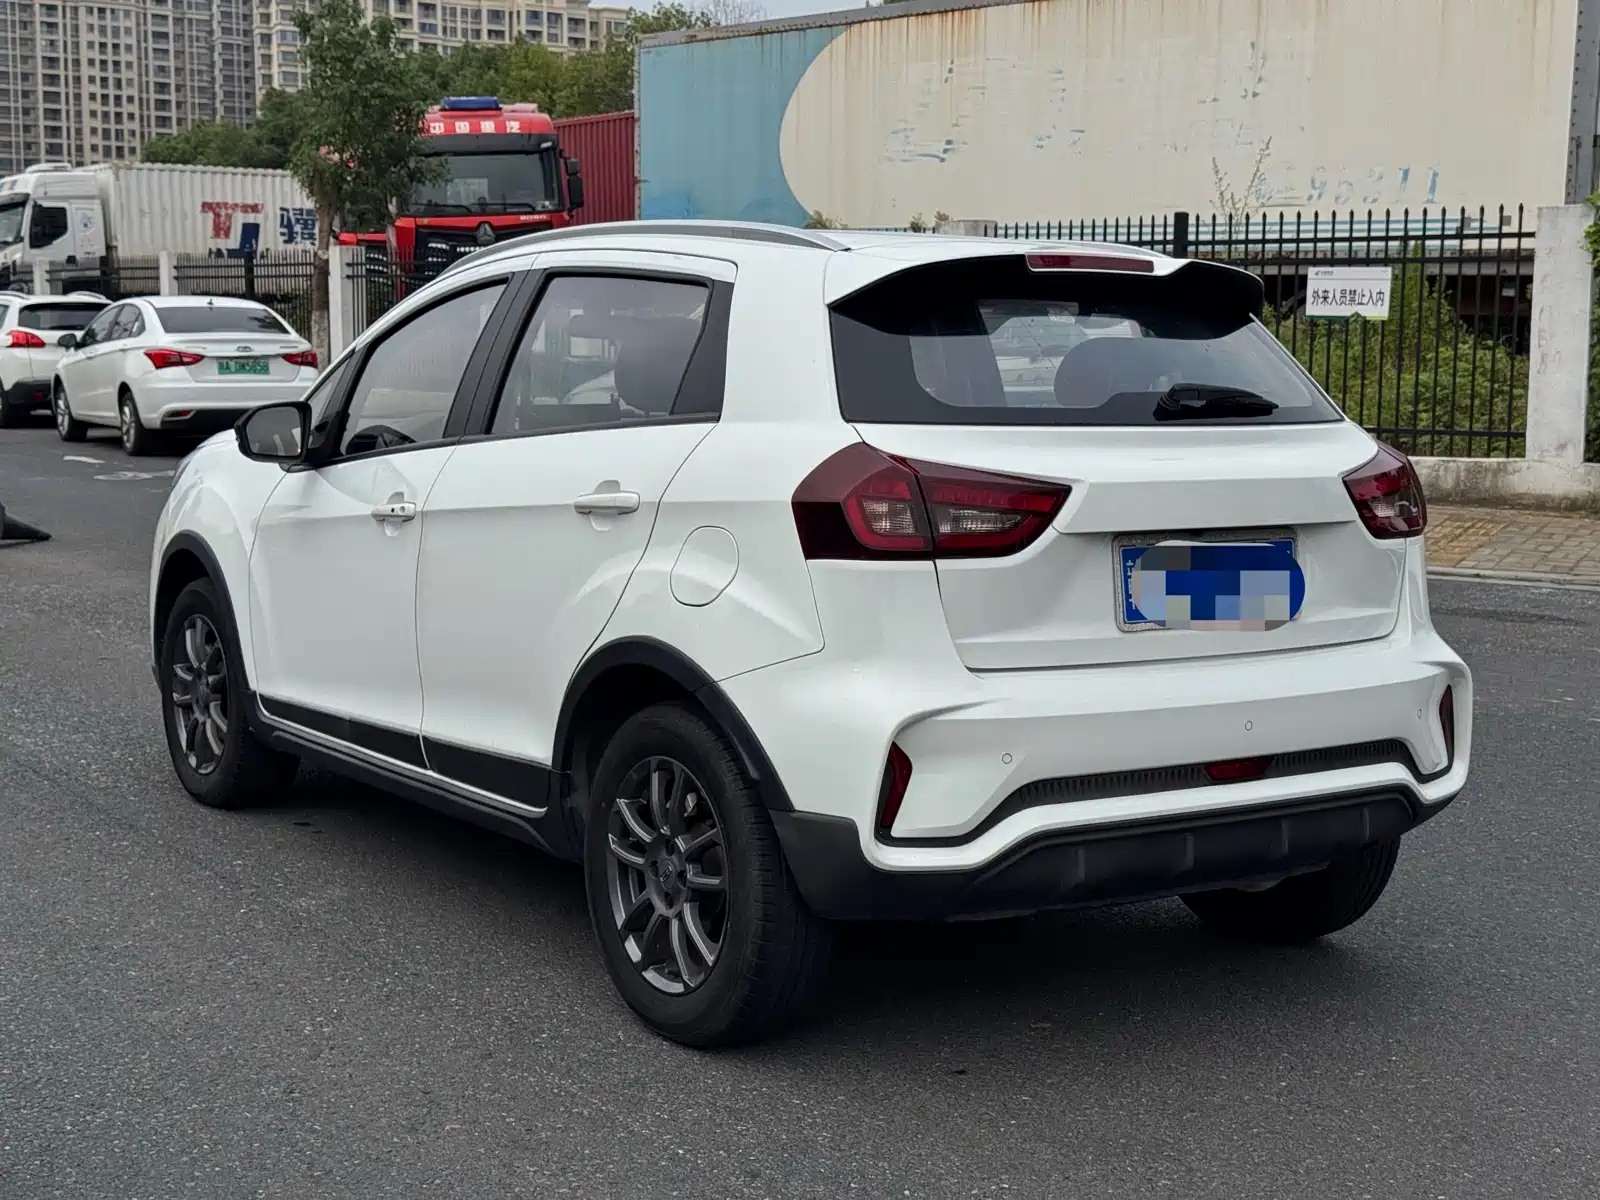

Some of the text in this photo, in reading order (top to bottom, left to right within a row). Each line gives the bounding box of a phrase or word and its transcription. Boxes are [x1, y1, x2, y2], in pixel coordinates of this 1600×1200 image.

[1311, 287, 1385, 307] 外来人员禁止入内
